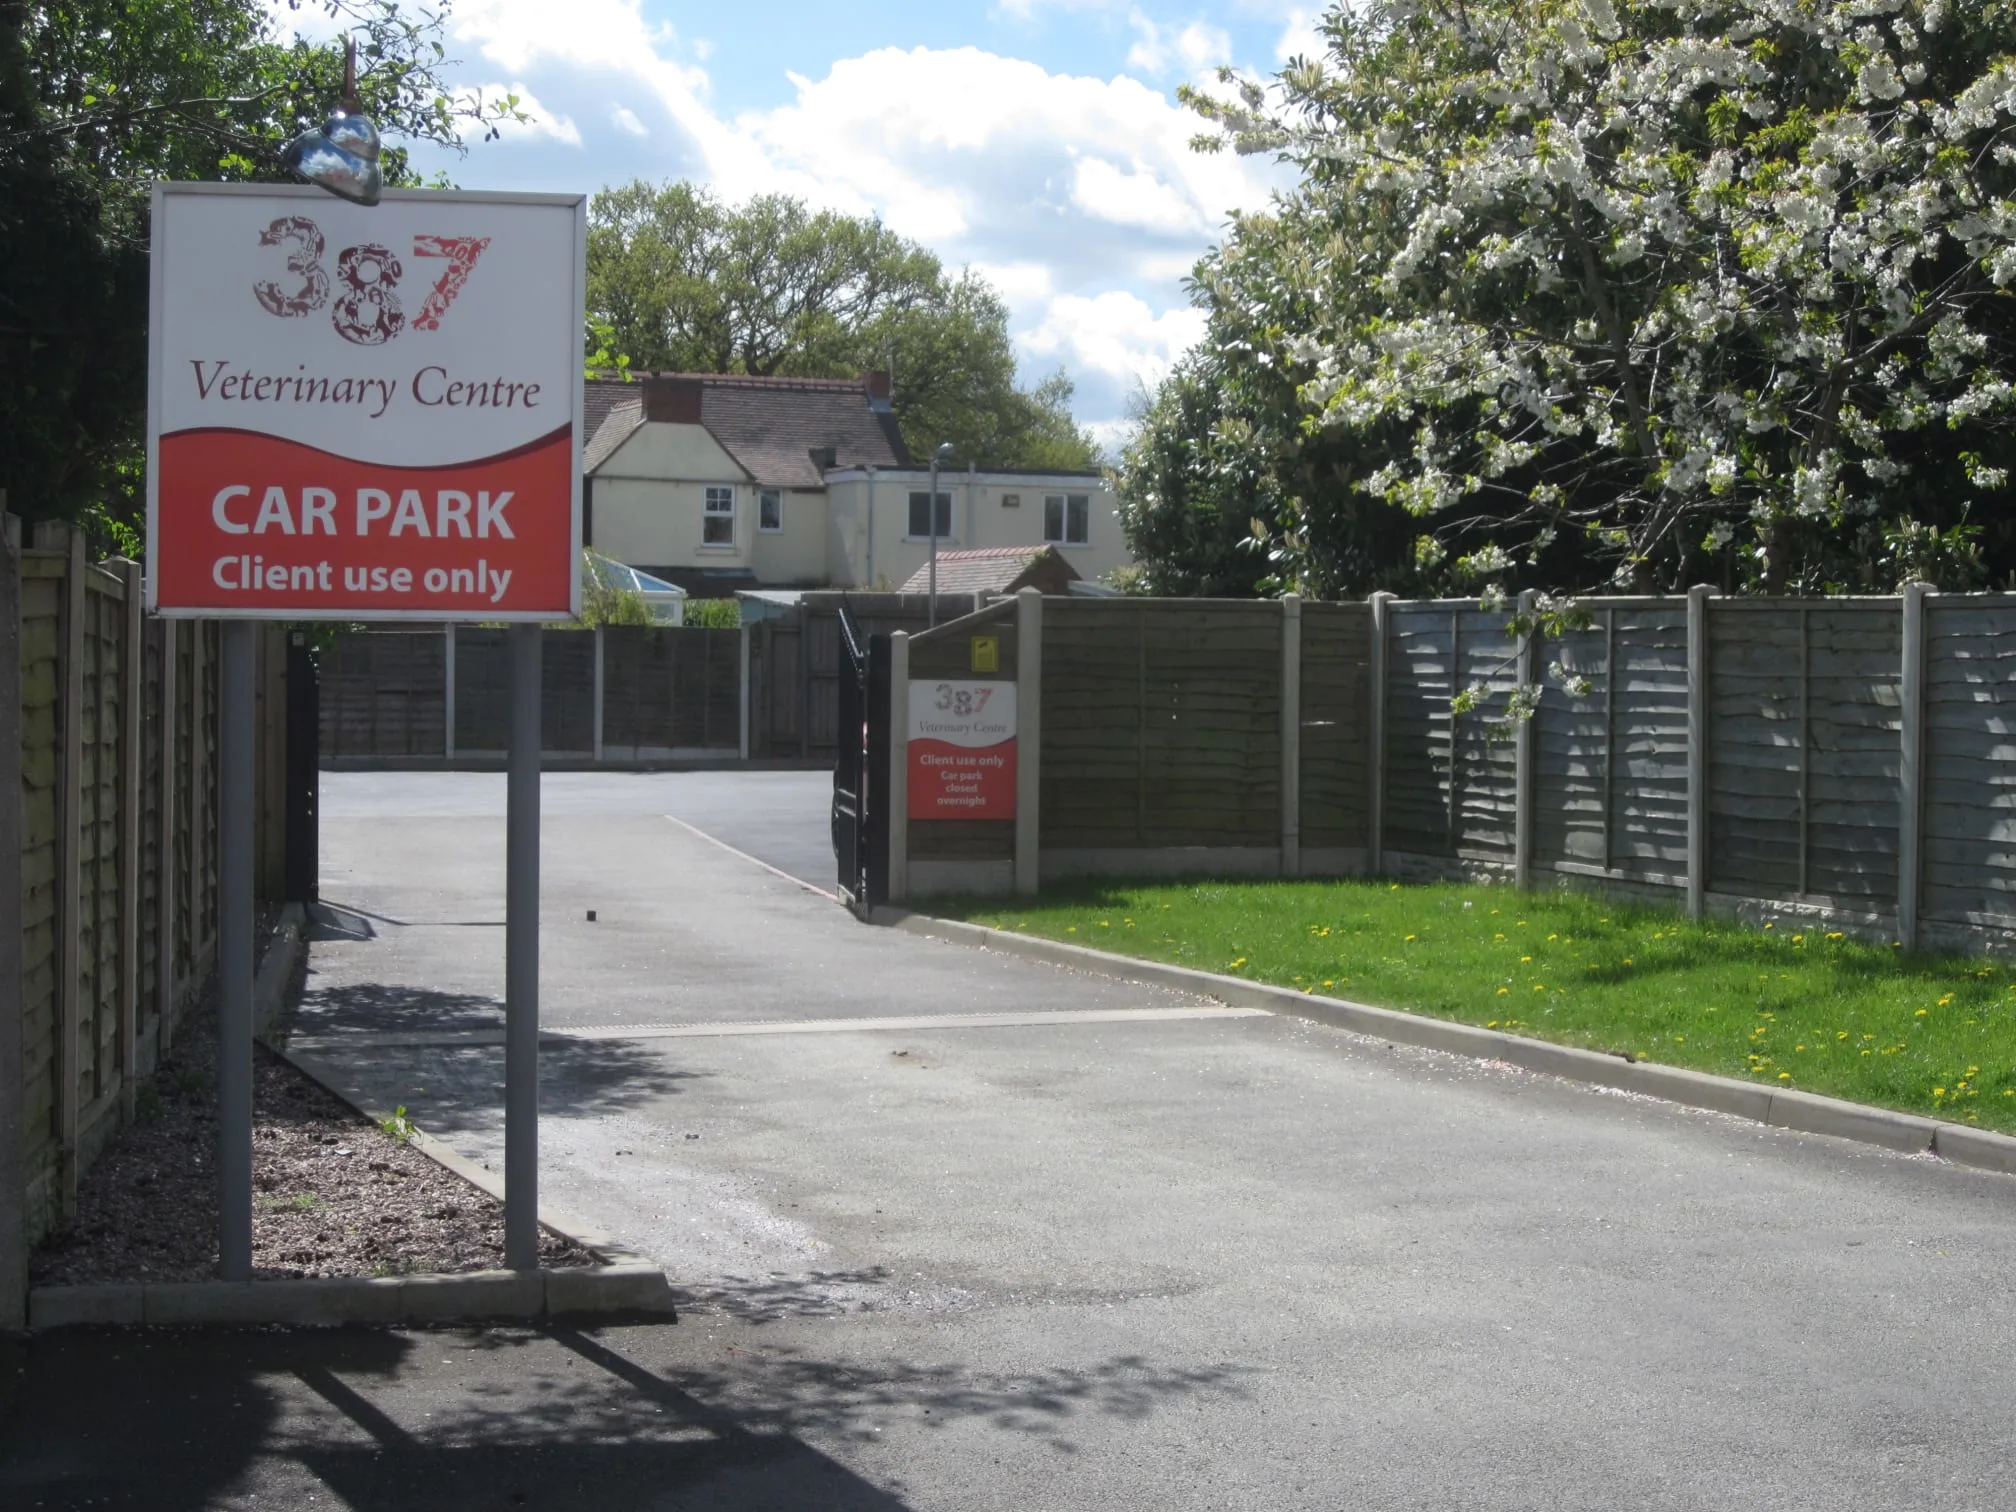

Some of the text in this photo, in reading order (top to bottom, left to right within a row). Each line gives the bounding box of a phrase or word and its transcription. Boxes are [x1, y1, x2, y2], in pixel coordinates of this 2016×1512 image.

[253, 216, 491, 345] 387
[190, 359, 541, 418] Veterinary Centre
[212, 485, 516, 539] CAR PARK
[212, 555, 512, 602] Client use only
[935, 683, 994, 717] 387
[919, 720, 1007, 735] Veterinary Centre
[920, 754, 1004, 769] Client use only
[941, 770, 983, 783] Car park
[945, 783, 978, 793] closed
[937, 795, 986, 808] overnight
